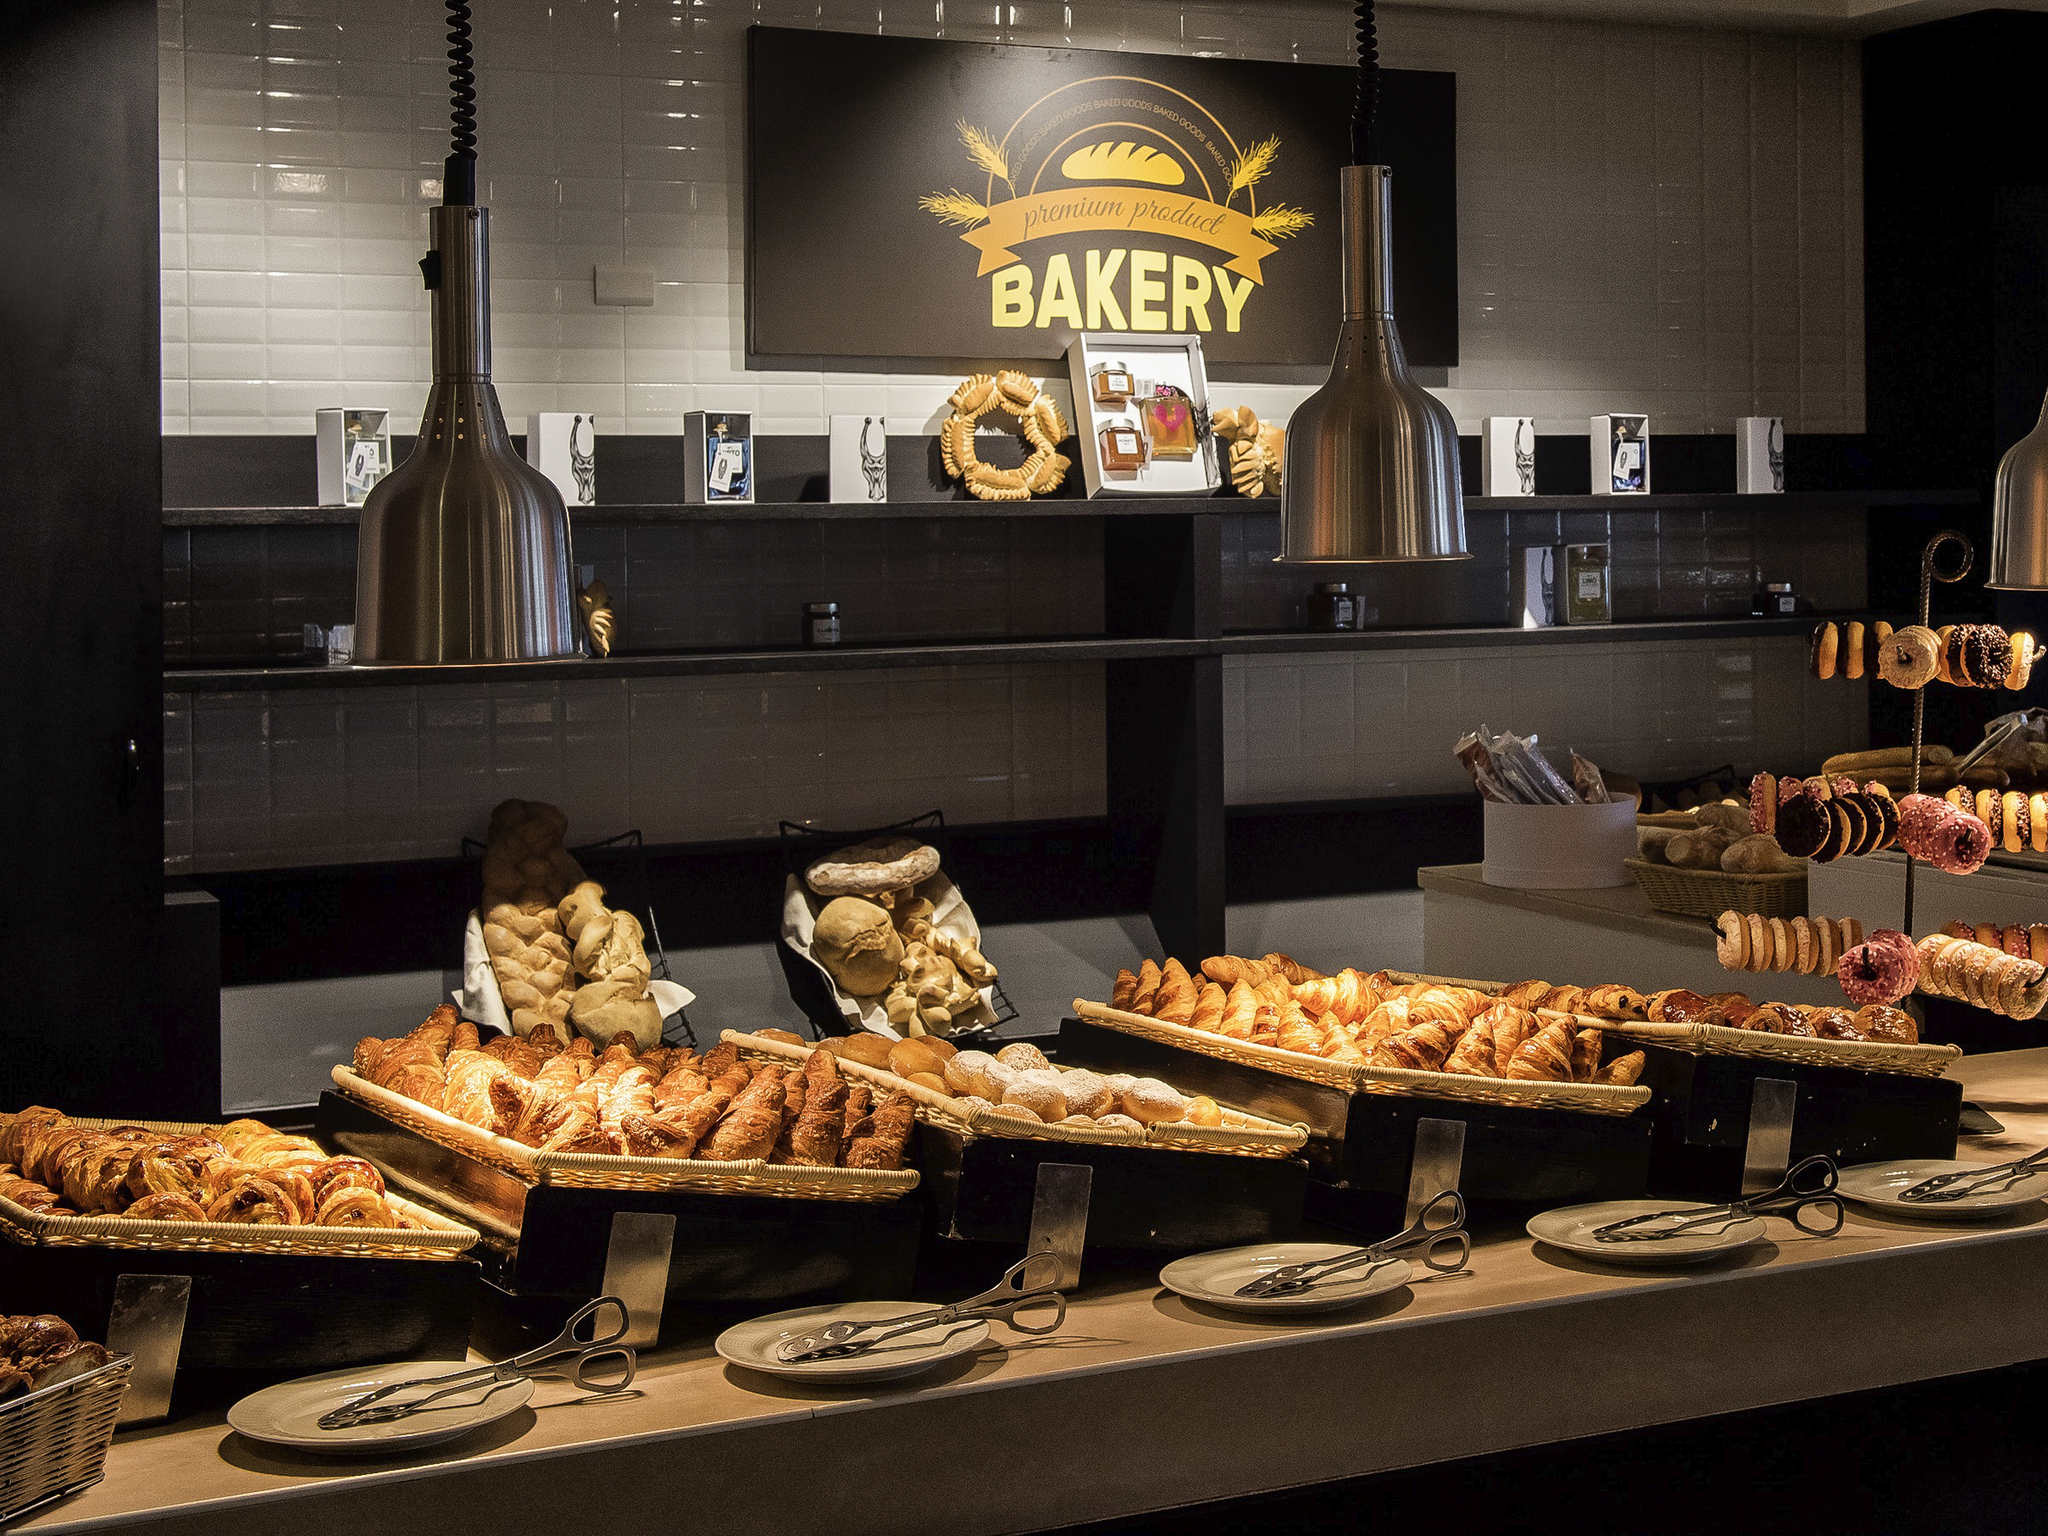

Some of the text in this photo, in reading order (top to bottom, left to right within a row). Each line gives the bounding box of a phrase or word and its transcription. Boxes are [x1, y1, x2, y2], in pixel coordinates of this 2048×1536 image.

[1121, 97, 1153, 112] GOODS
[1153, 104, 1179, 122] BAKED
[1179, 117, 1207, 143] GOODS
[1205, 140, 1226, 167] BAKED
[1023, 197, 1226, 240] premium product
[992, 248, 1255, 333] BAKERY
